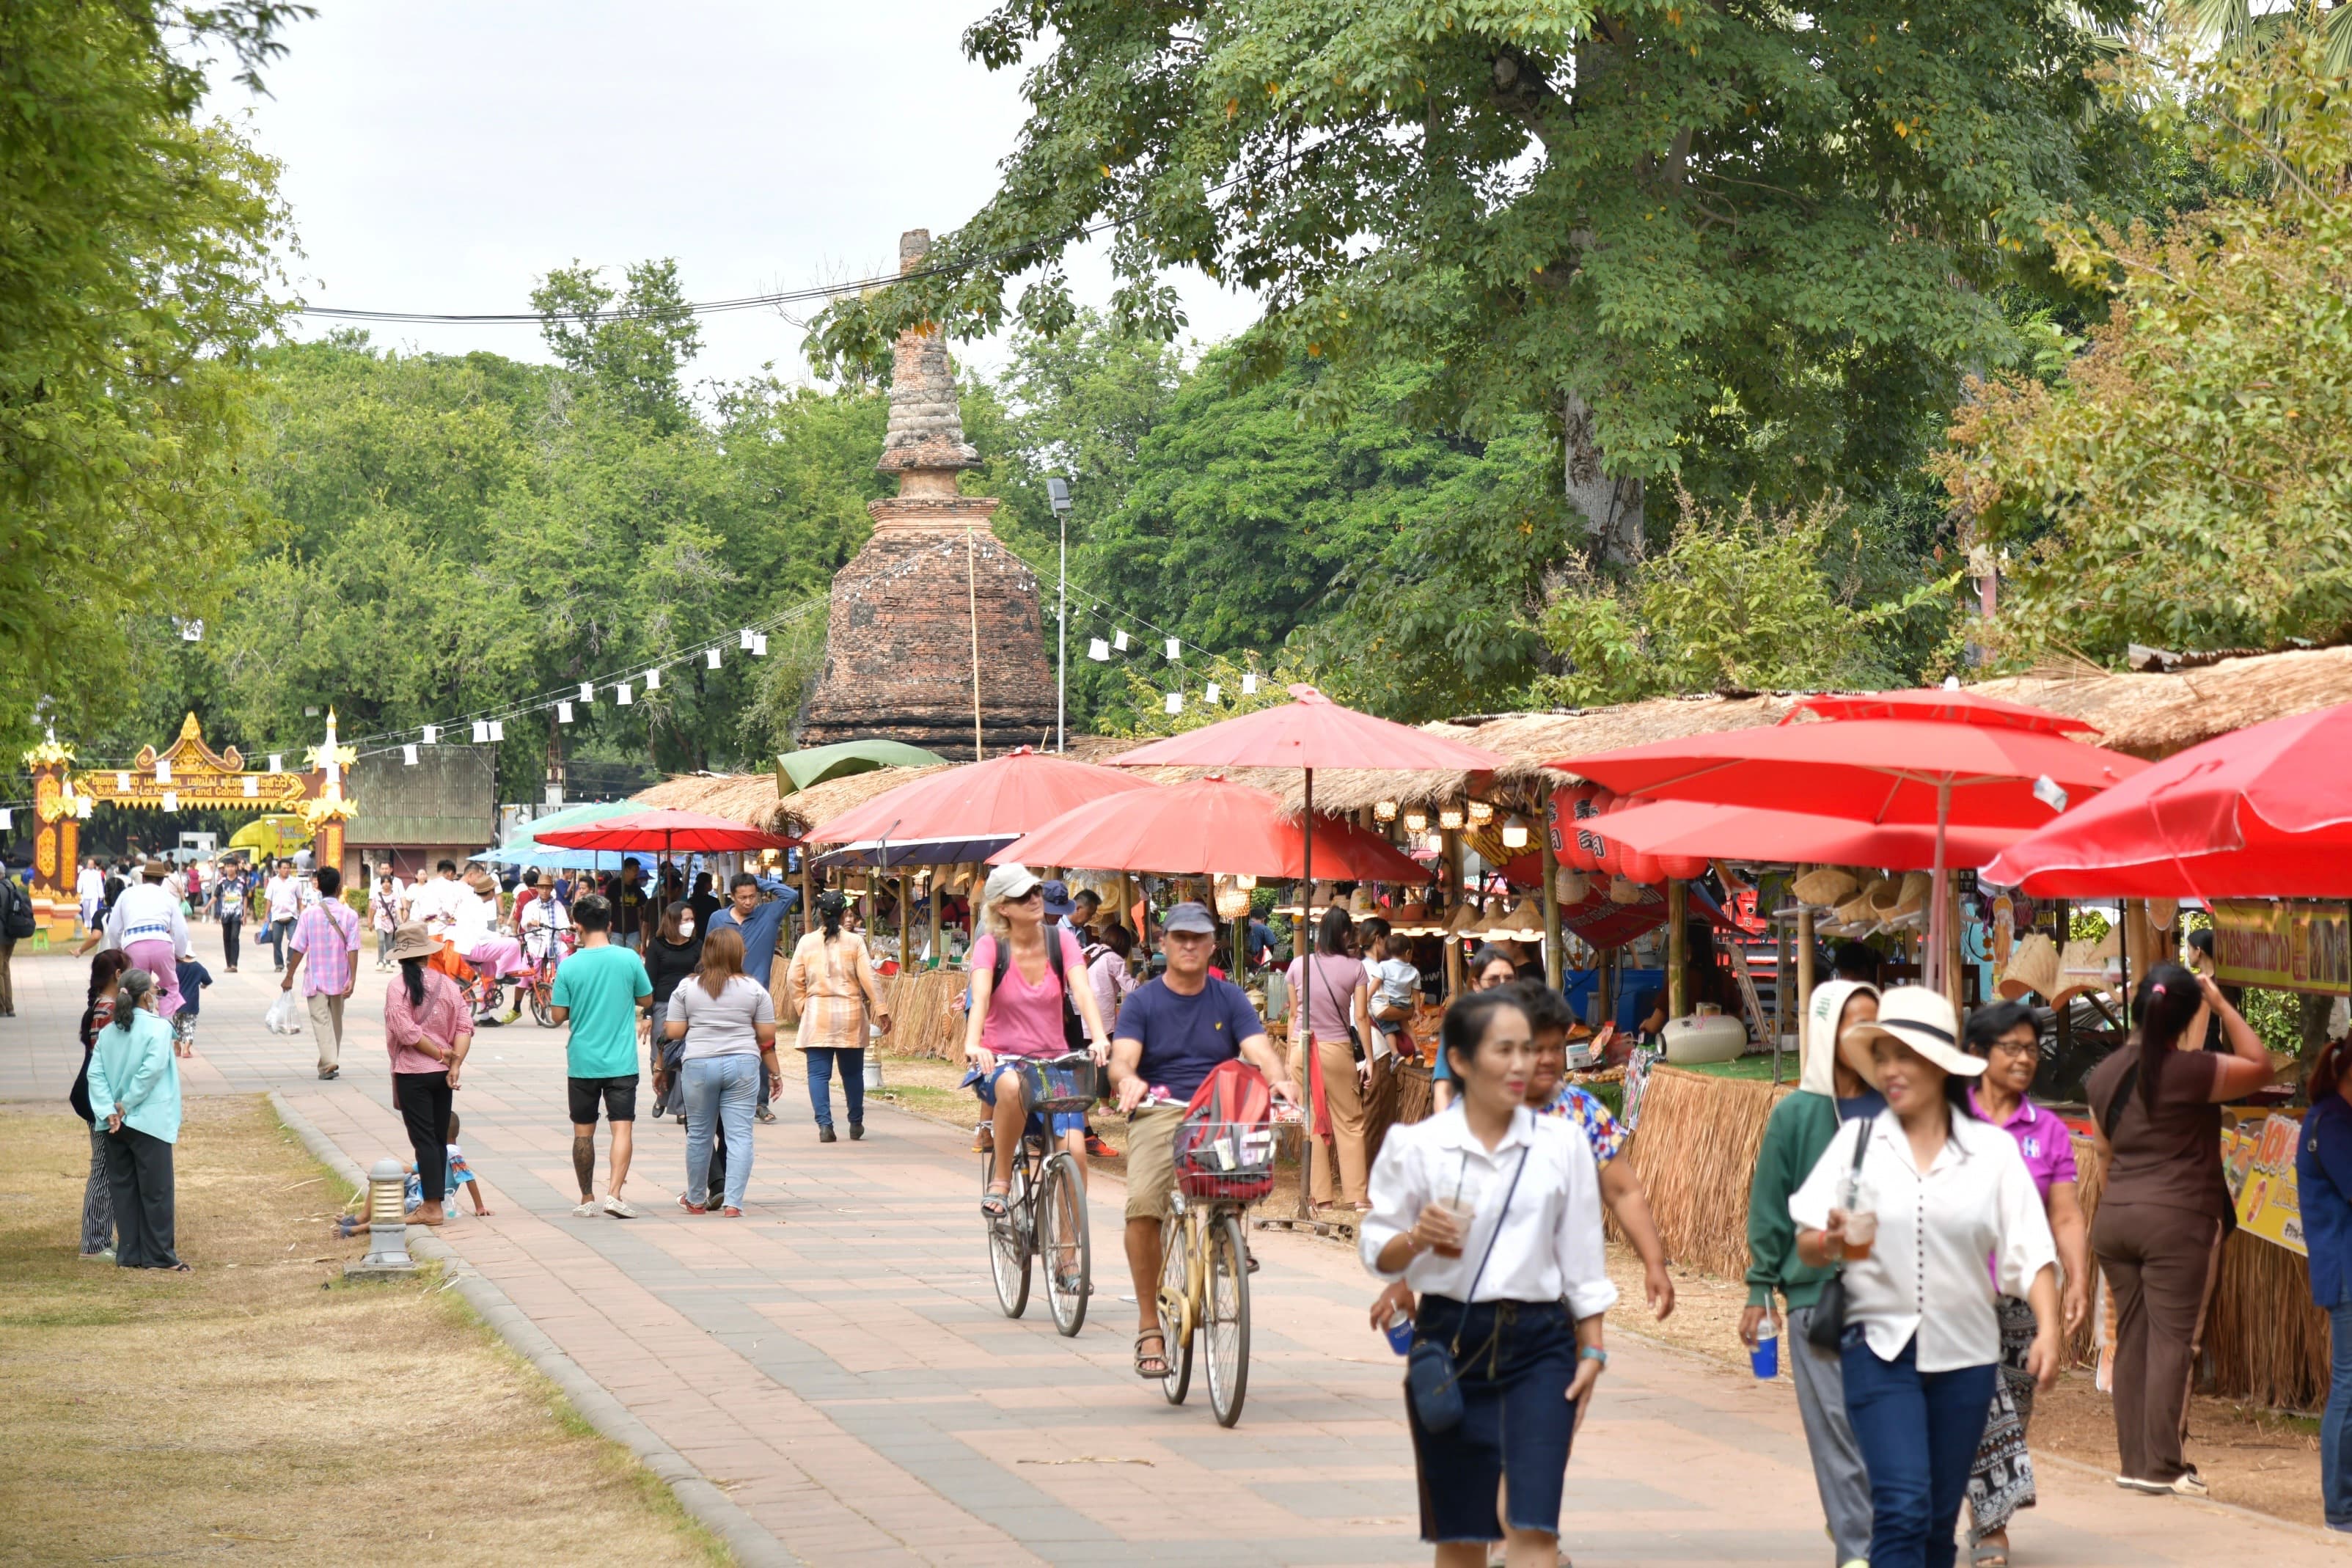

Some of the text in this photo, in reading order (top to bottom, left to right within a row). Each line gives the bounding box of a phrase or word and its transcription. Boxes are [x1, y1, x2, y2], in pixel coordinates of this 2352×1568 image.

[97, 786, 137, 795] Sukhai
[196, 788, 212, 796] and
[257, 788, 284, 797] estival
